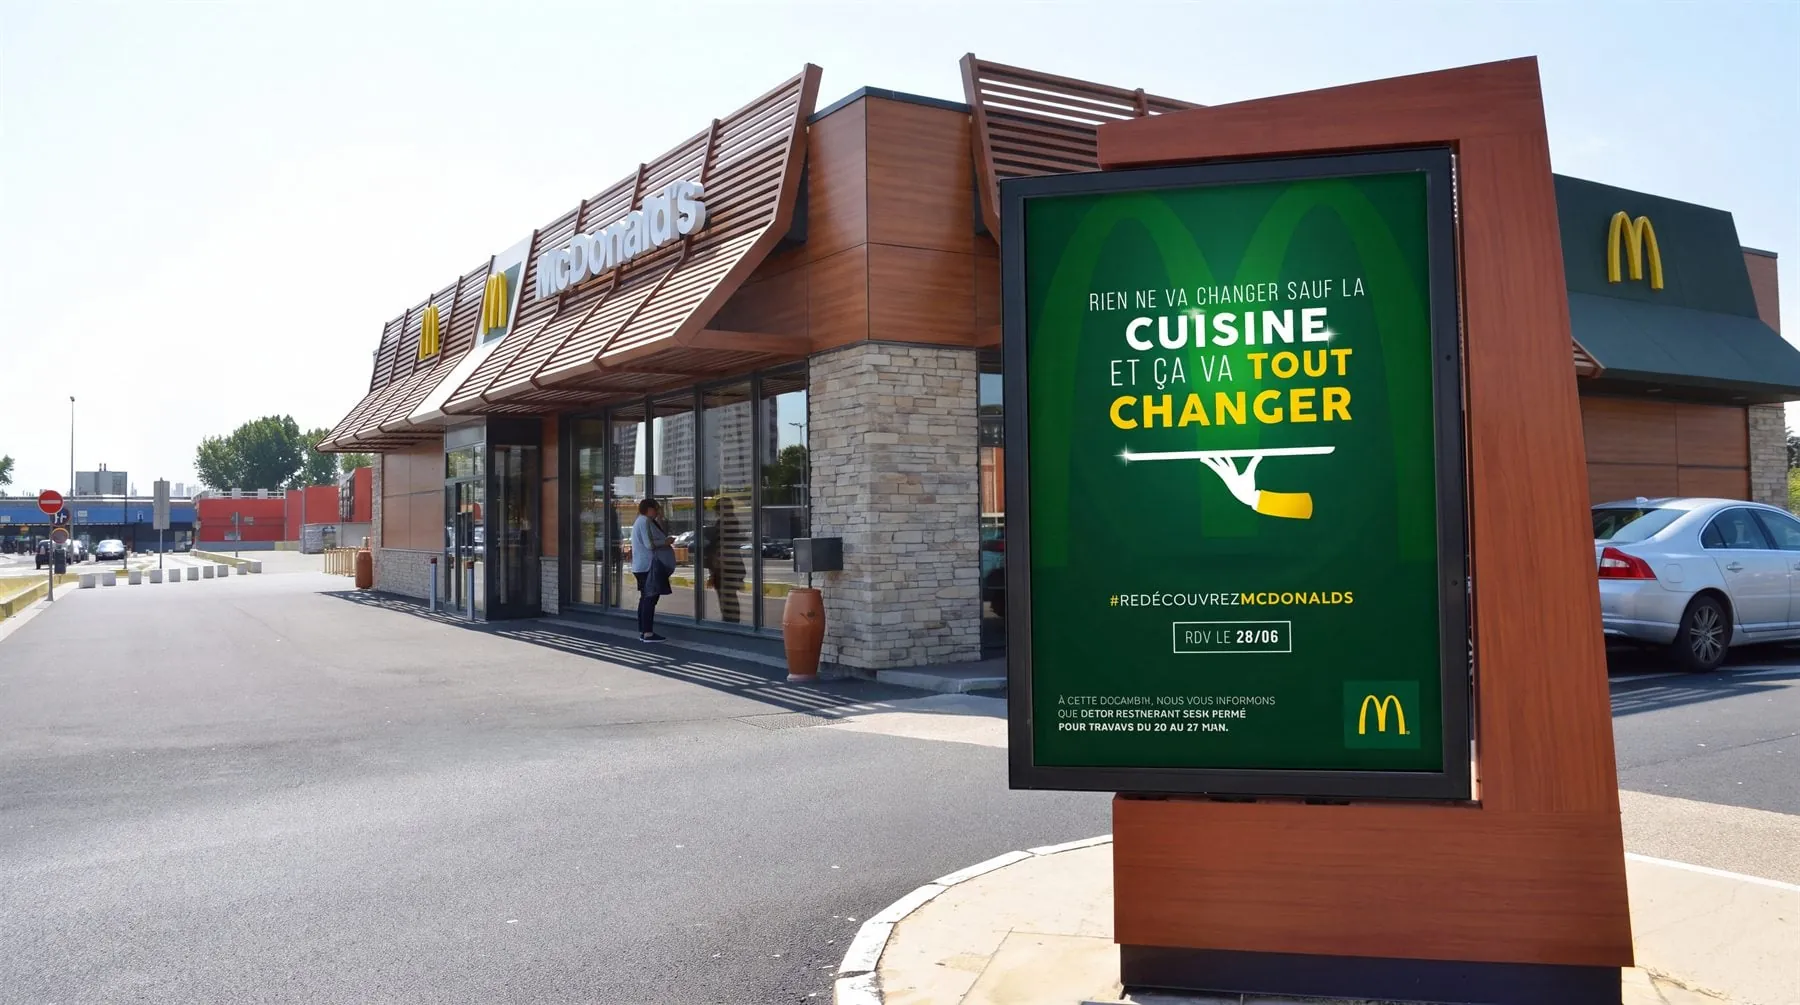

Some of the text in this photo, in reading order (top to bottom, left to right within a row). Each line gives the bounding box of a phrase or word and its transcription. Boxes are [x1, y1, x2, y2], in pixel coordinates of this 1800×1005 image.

[535, 179, 706, 301] McDonald's
[1089, 277, 1365, 311] RIEN NE VA CHANGER SAUF LA
[1125, 307, 1329, 351] CUISINE
[1110, 348, 1353, 390] ET ÇA VA TOUT
[1109, 386, 1353, 430] CHANGER
[1110, 590, 1354, 607] #REDÉCOUVREZMCDONALDS
[1185, 629, 1279, 644] RDV LE 28/06
[1058, 694, 1065, 705] À
[1067, 696, 1098, 705] CETTE
[1156, 696, 1185, 705] NOUS
[1186, 696, 1214, 705] VOUS
[1216, 696, 1276, 705] INFORMONS
[1057, 709, 1078, 719] QUE
[1080, 709, 1114, 718] DETOR
[1182, 709, 1210, 719] SESK
[1211, 707, 1247, 719] PERMÉ
[1058, 722, 1087, 732] POUR
[1088, 722, 1135, 732] TRAVAVS
[1136, 722, 1152, 732] DU
[1153, 722, 1168, 732] 20
[1169, 722, 1184, 732] AU
[1186, 722, 1199, 732] 27
